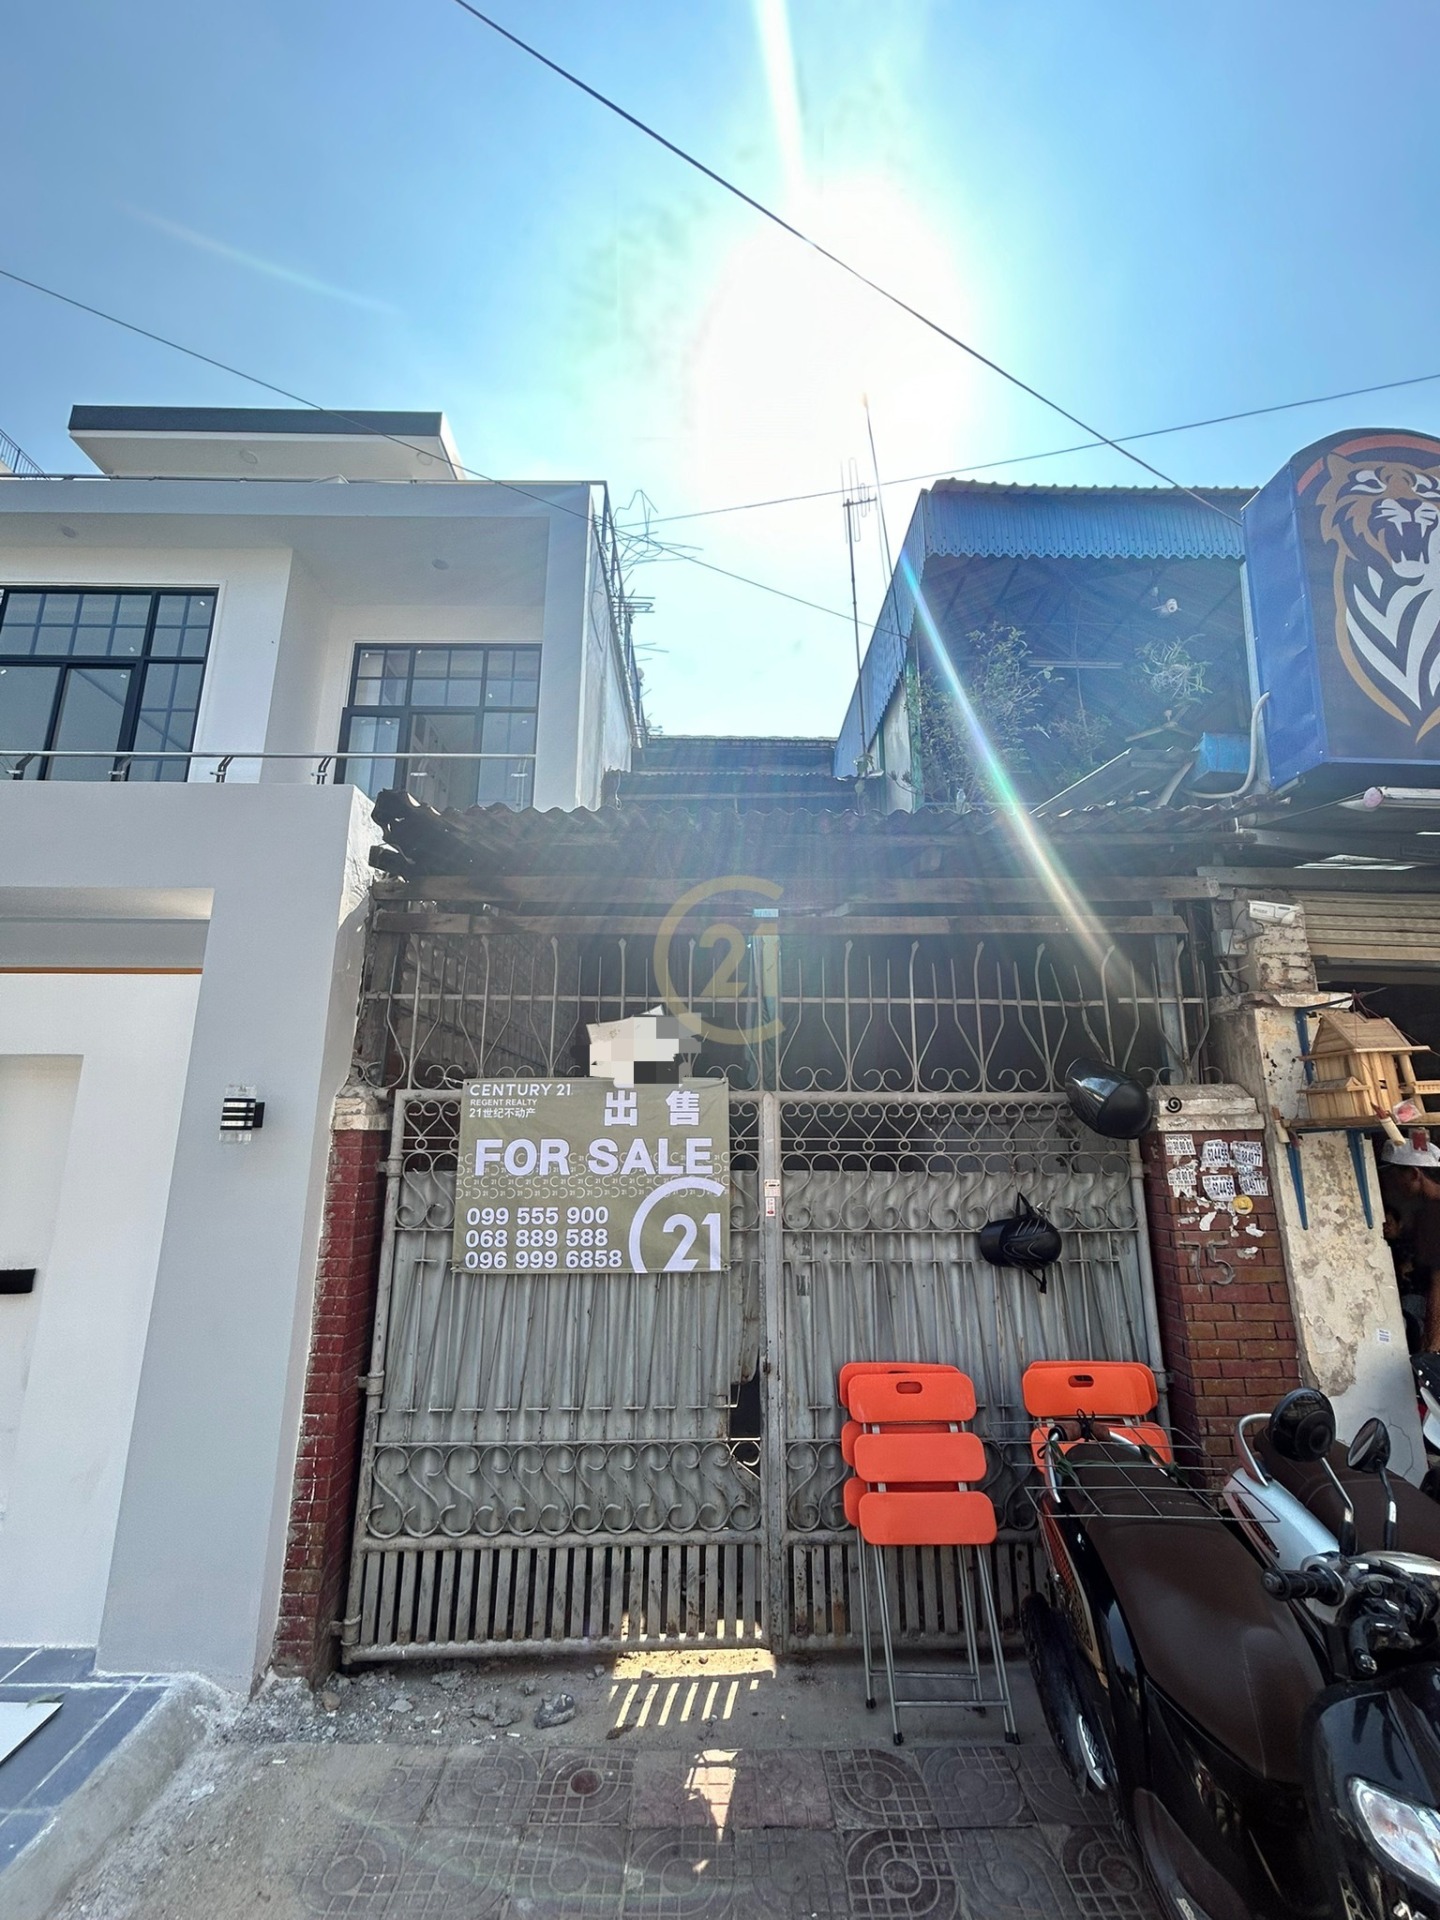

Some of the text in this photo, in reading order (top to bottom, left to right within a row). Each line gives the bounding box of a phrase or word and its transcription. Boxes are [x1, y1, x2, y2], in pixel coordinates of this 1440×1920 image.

[470, 1083, 572, 1096] CENTURY 21
[505, 1098, 537, 1106] REALTY
[604, 1090, 700, 1127] 出售
[469, 1107, 536, 1119] 21世纪不动产
[474, 1137, 713, 1177] FOR SALE
[466, 1206, 609, 1225] 099 555 900
[465, 1228, 608, 1248] 068 889 588
[465, 1250, 622, 1269] 096 999 6858
